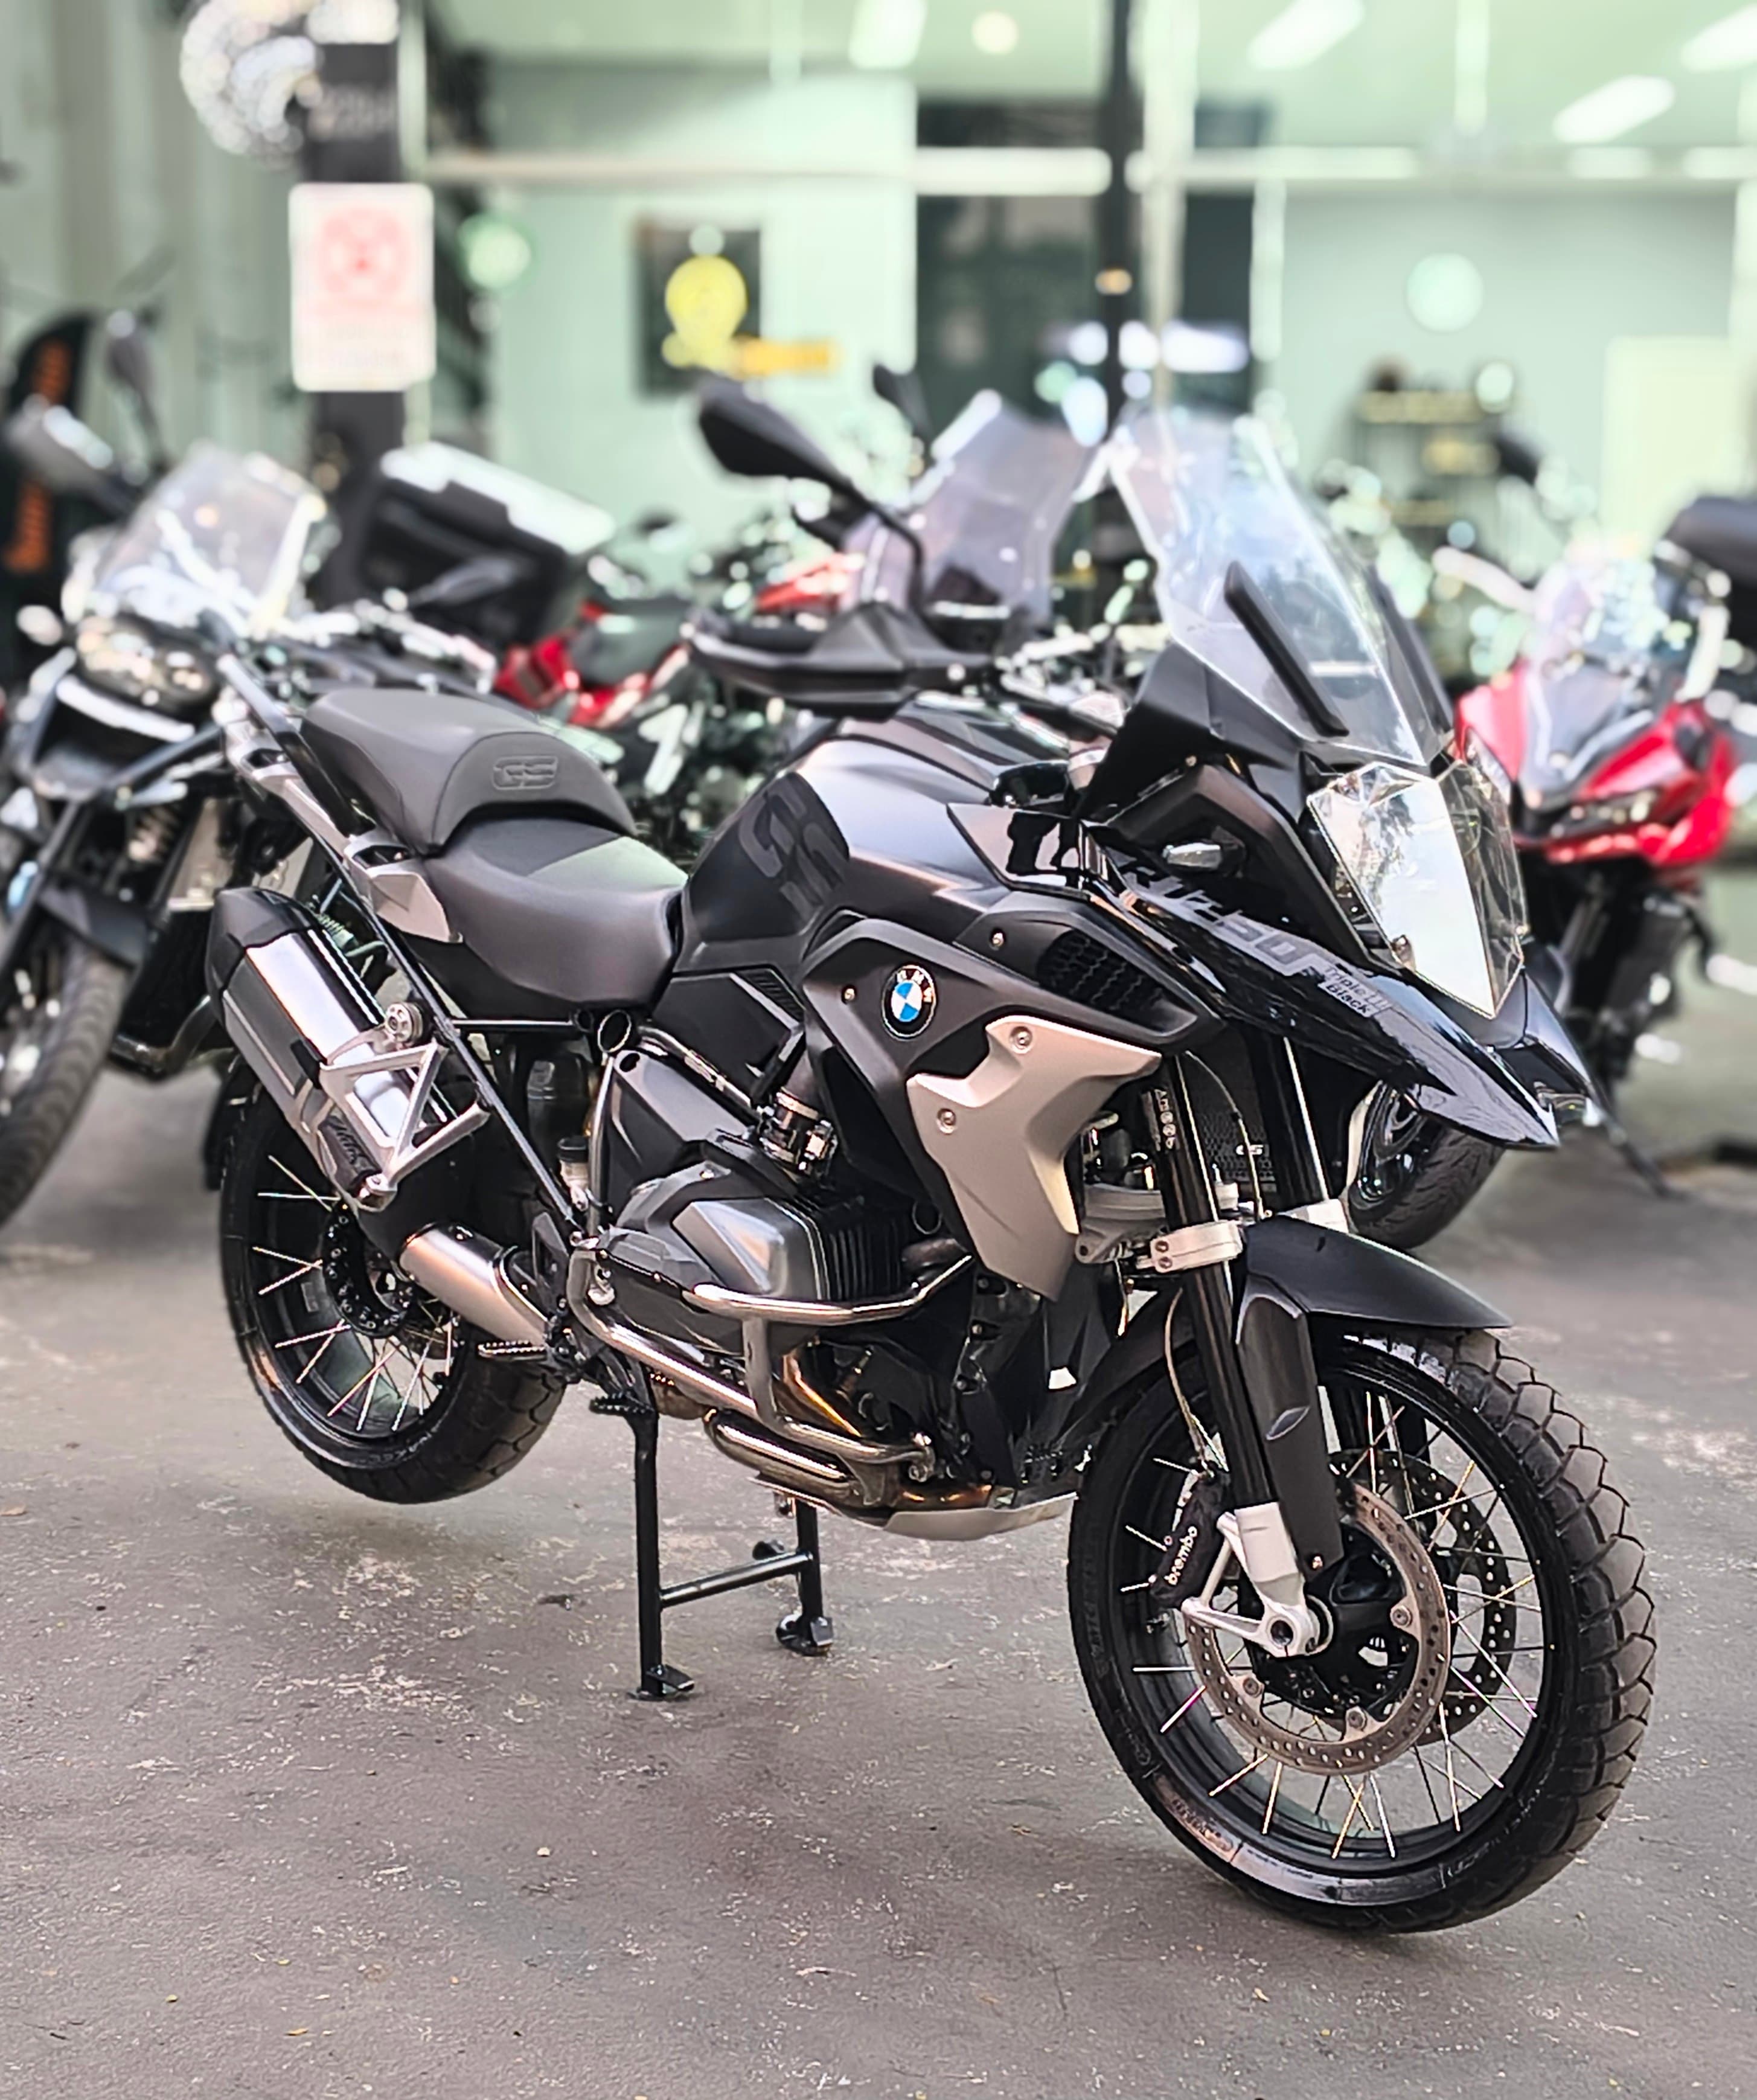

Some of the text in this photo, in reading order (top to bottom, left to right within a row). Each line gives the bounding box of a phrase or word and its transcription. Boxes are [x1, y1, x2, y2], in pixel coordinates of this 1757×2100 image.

[492, 755, 558, 790] GS
[738, 775, 848, 923] GS
[897, 968, 932, 1003] BMW
[1325, 966, 1367, 996] Triple
[1325, 984, 1371, 1014] Black
[1163, 1526, 1198, 1586] brembo
